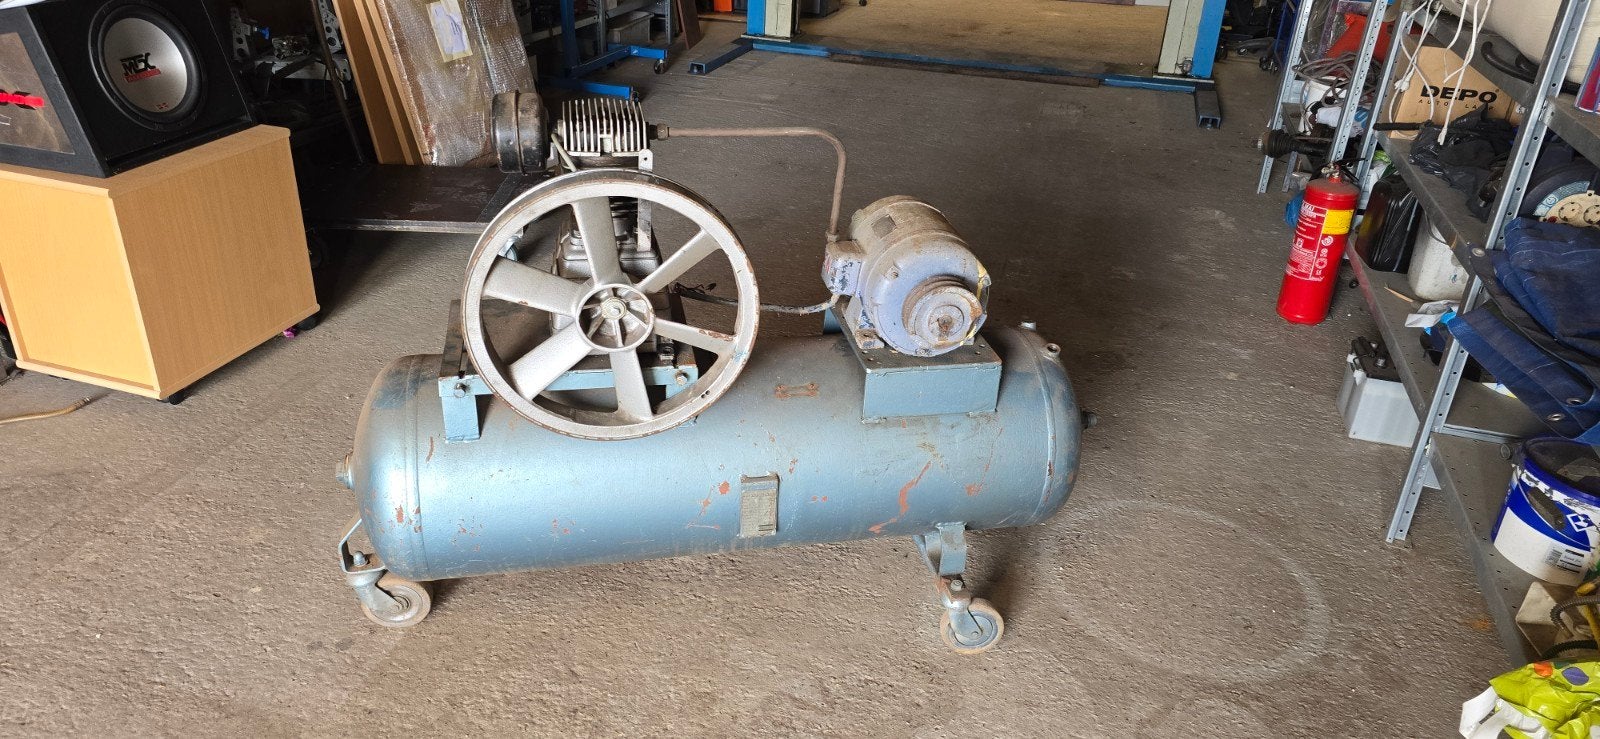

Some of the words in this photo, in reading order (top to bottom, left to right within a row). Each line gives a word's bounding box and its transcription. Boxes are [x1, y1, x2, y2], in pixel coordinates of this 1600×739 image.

[1420, 85, 1498, 104] DEPO
[1418, 99, 1449, 107] AUTO
[1465, 103, 1494, 111] LAP
